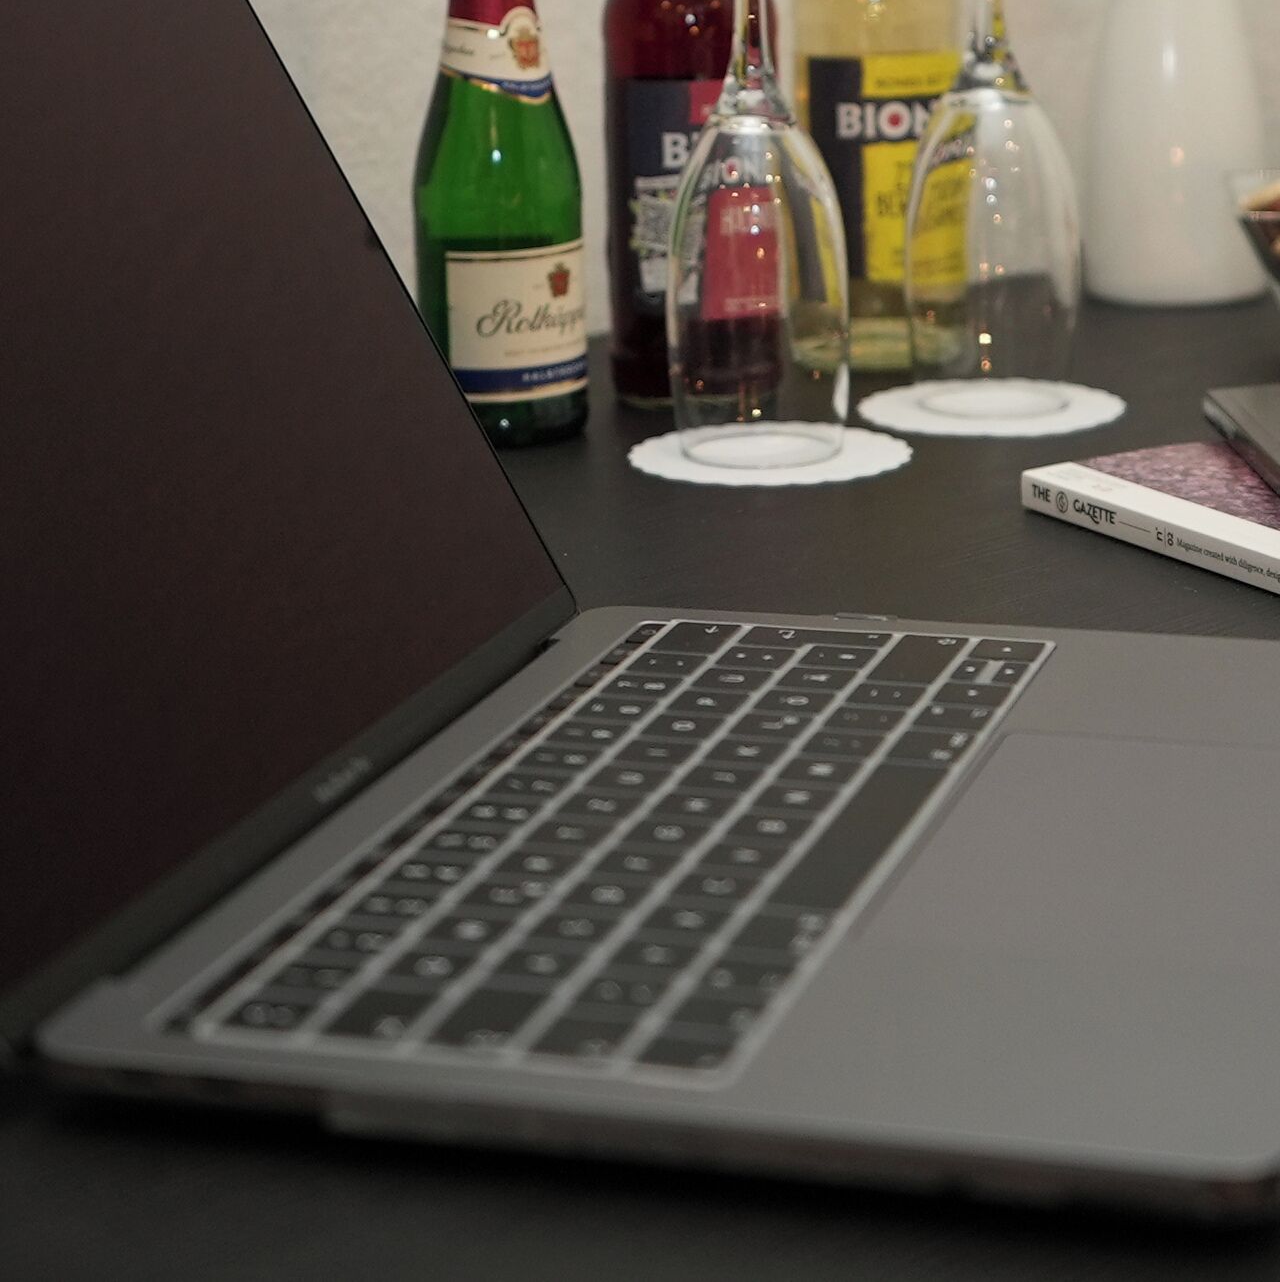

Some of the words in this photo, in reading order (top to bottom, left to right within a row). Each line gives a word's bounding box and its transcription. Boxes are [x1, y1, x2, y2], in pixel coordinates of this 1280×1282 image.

[1032, 483, 1051, 503] THE
[1073, 498, 1117, 525] GAZETTE
[1176, 537, 1202, 553] Magazine
[1203, 548, 1224, 561] created
[1225, 555, 1238, 566] with
